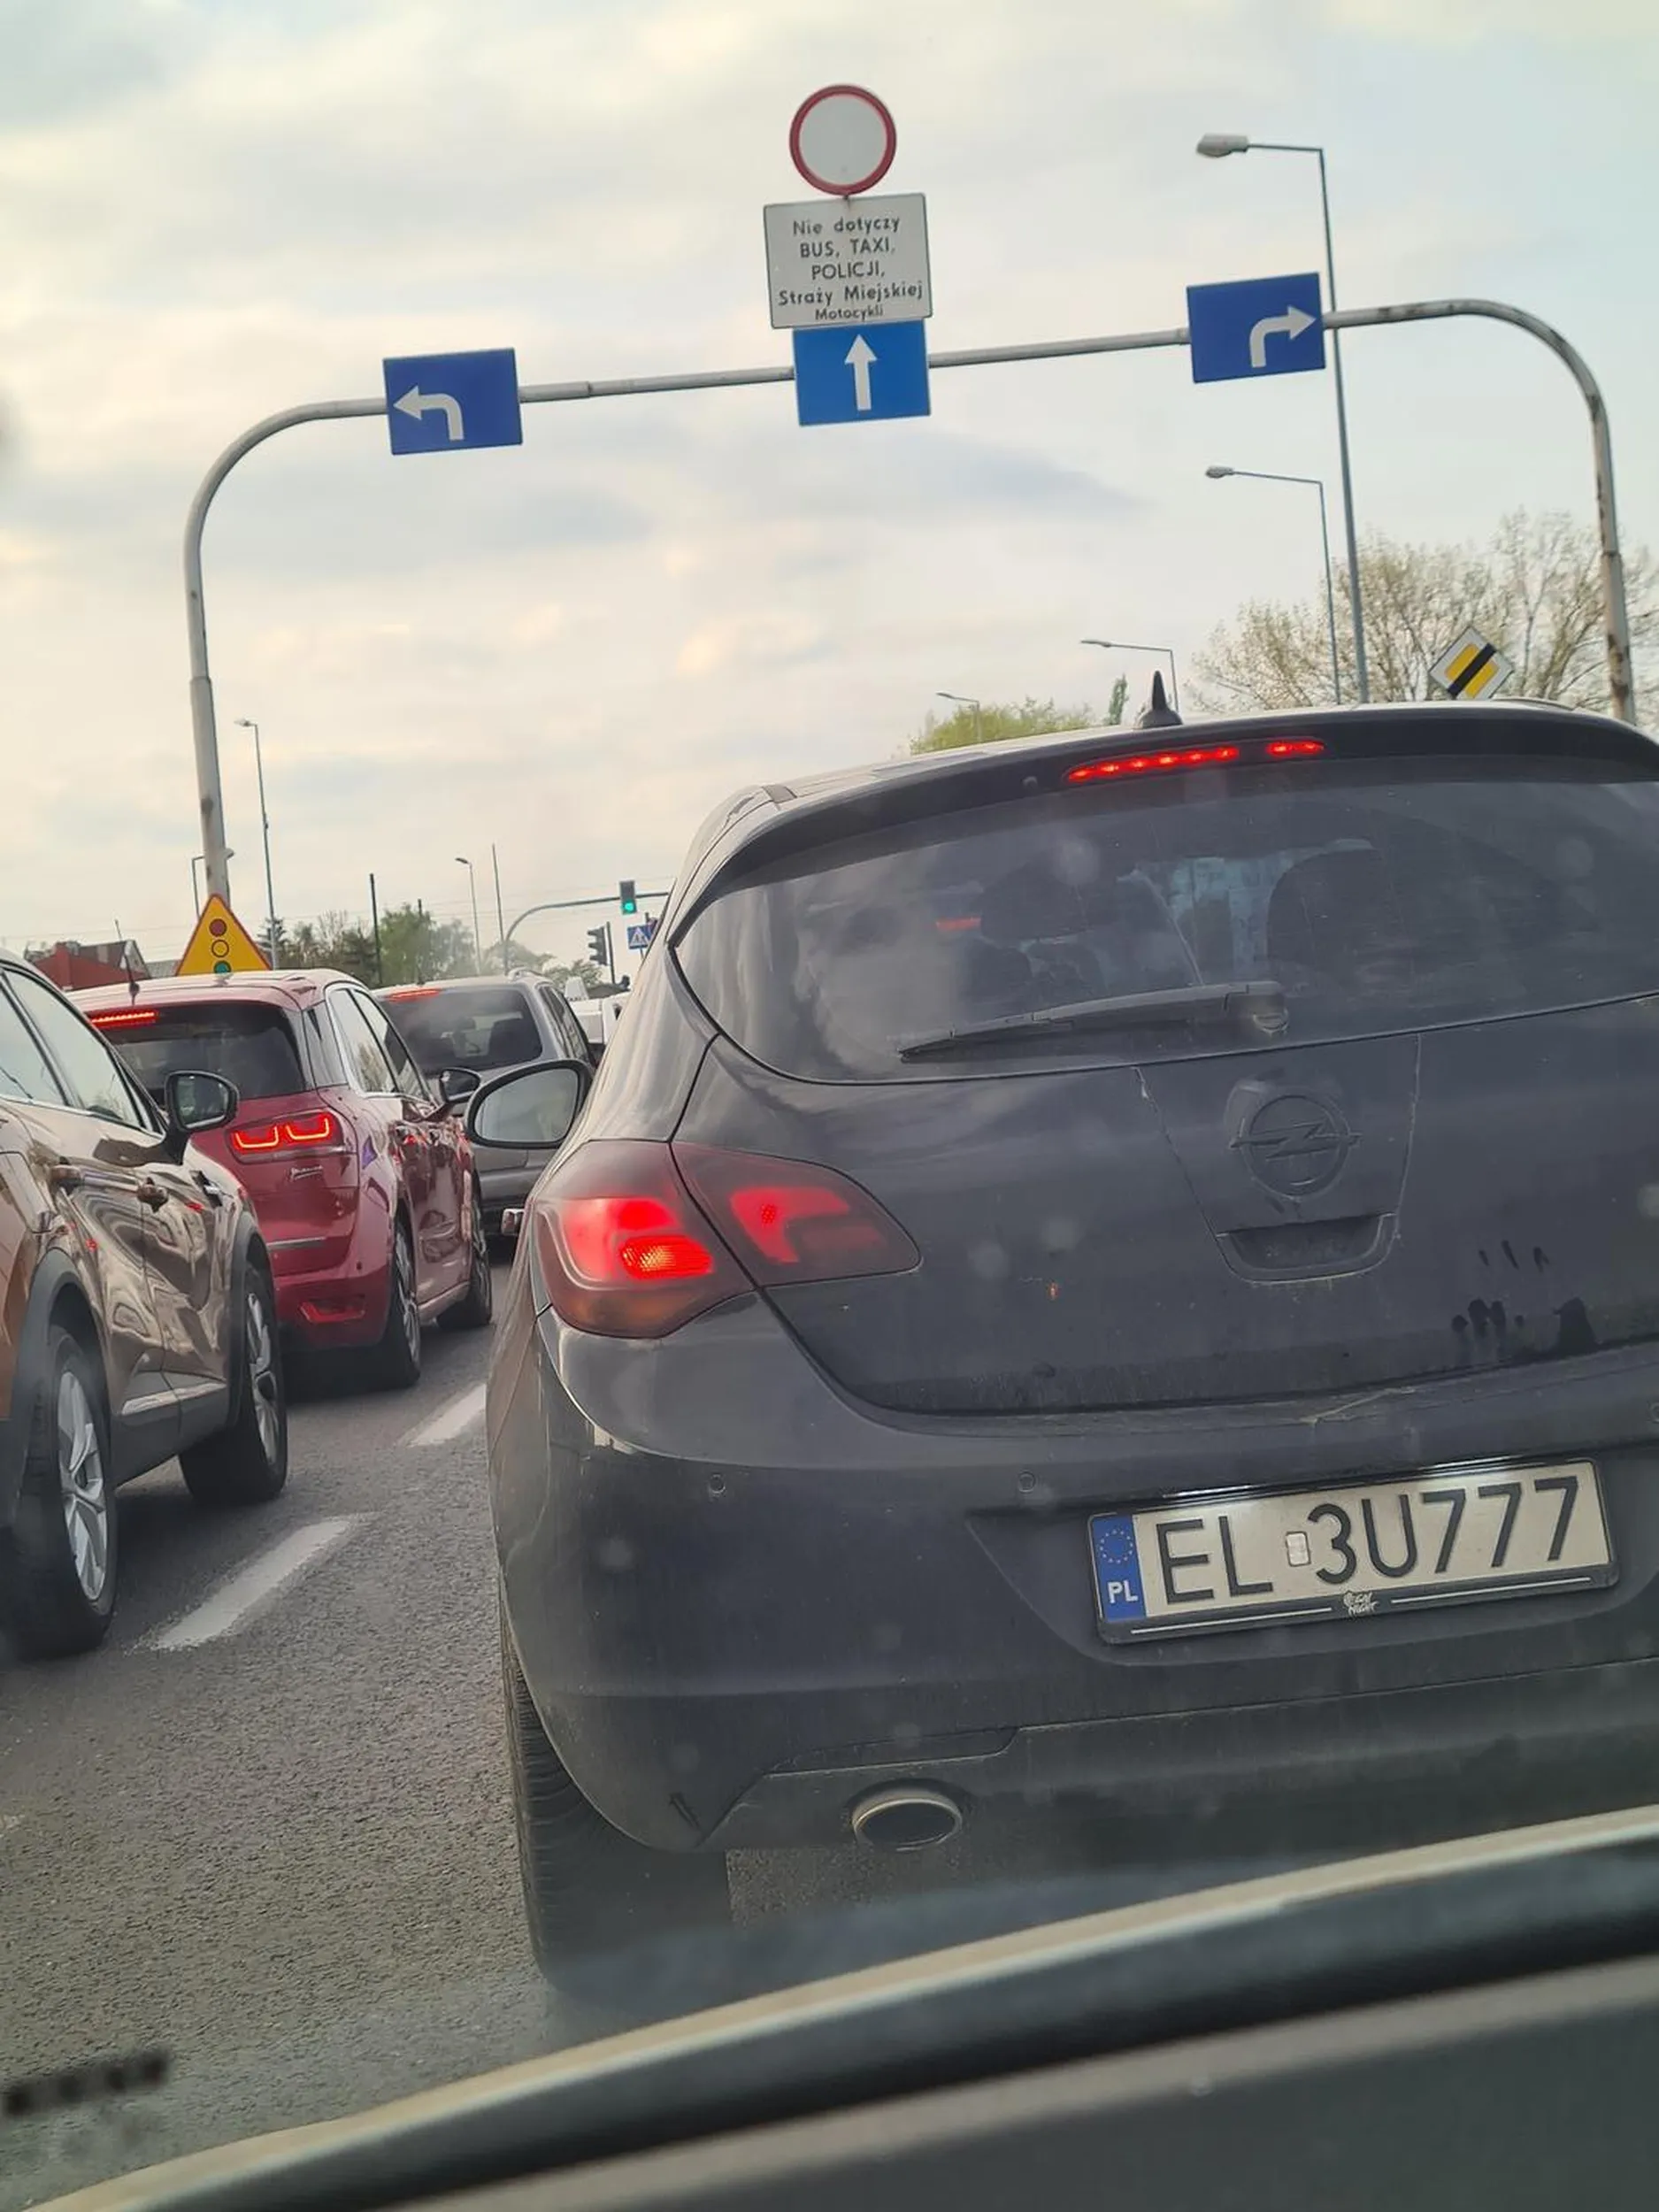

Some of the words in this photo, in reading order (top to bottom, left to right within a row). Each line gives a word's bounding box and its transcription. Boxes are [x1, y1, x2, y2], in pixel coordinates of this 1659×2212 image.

[793, 220, 823, 235] Nie
[833, 216, 900, 234] dotyczy
[800, 240, 841, 258] BUS,
[849, 236, 896, 255] TAXI,
[811, 260, 885, 280] POLICJI,
[778, 287, 833, 307] Straży
[844, 280, 923, 303] Miejskiej
[815, 303, 884, 322] Motocykli
[1156, 1516, 1274, 1605] EL
[1307, 1475, 1578, 1585] 3U777
[1107, 1579, 1140, 1604] PL
